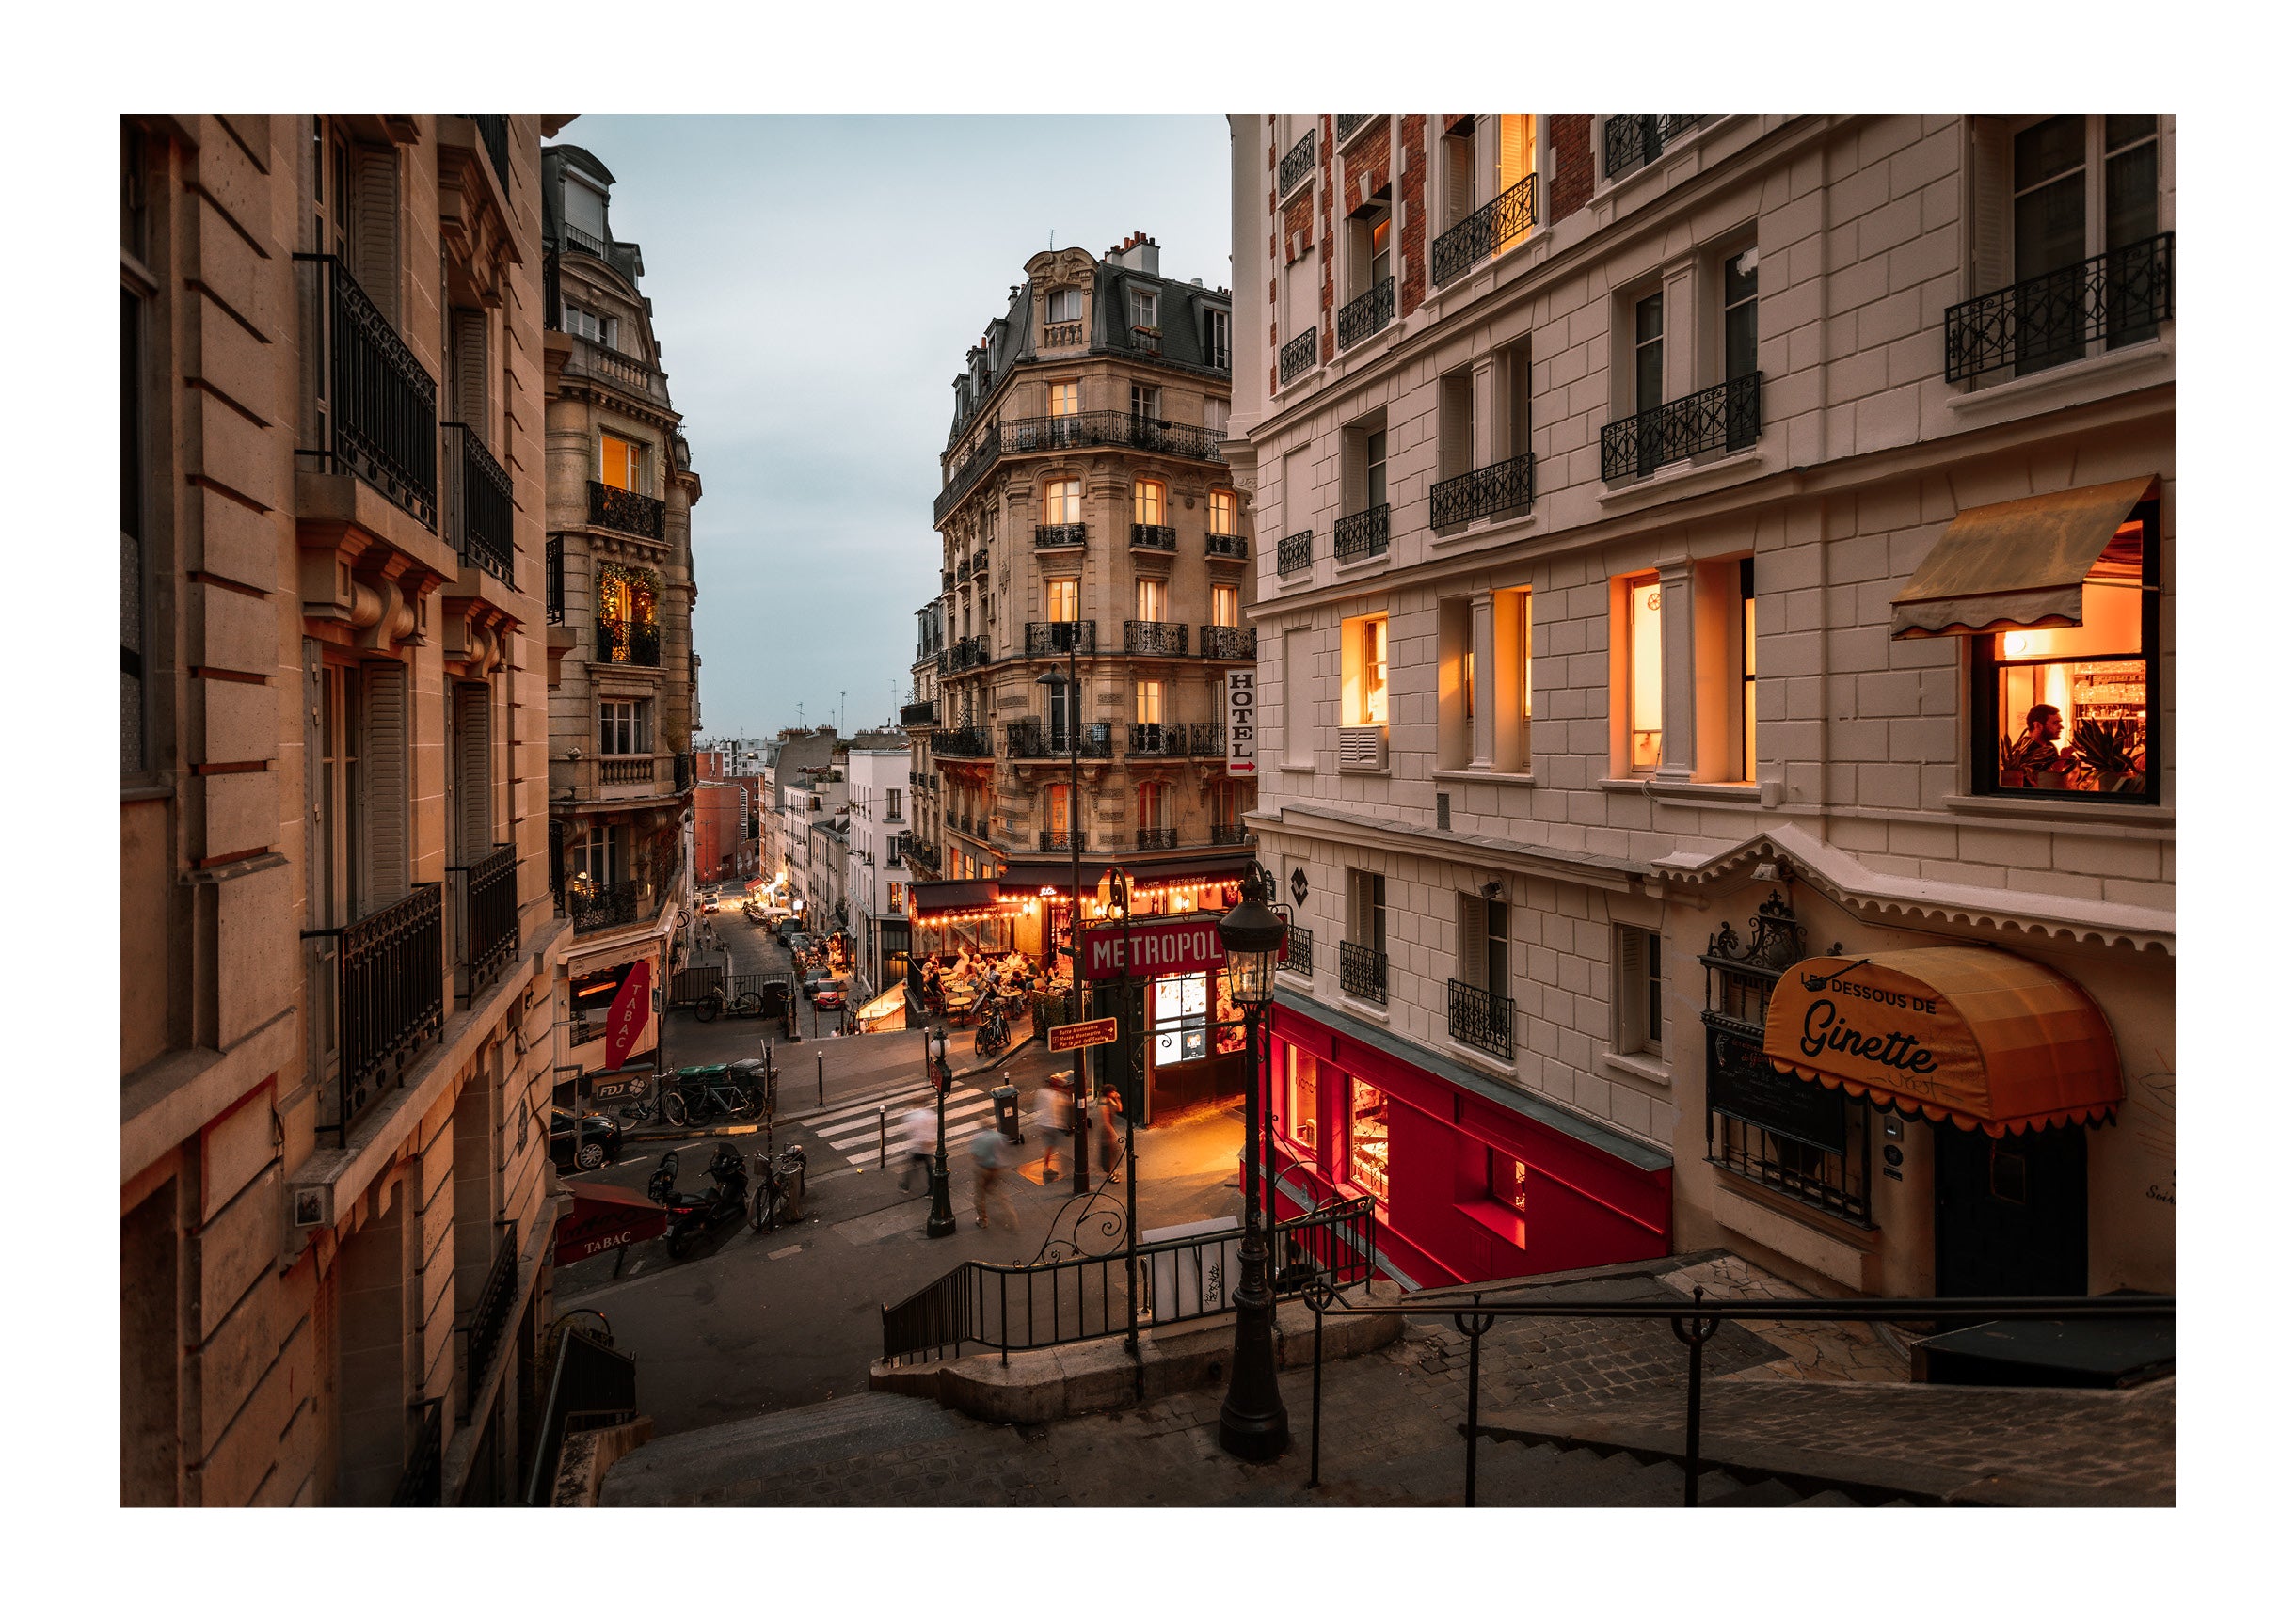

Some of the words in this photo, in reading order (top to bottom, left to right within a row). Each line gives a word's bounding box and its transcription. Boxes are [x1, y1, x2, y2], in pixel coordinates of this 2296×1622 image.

[1229, 674, 1254, 758] HOTEL
[1169, 876, 1208, 886] RESTAURANT
[1093, 930, 1222, 970] METROPOL
[1832, 978, 1906, 1009] DESSOUS
[1913, 997, 1937, 1015] DE
[616, 984, 642, 1048] TABAC
[1800, 999, 1938, 1075] Ginette
[599, 1083, 625, 1097] FDJ
[2145, 1185, 2176, 1205] Soir
[584, 1231, 631, 1254] TABAC
